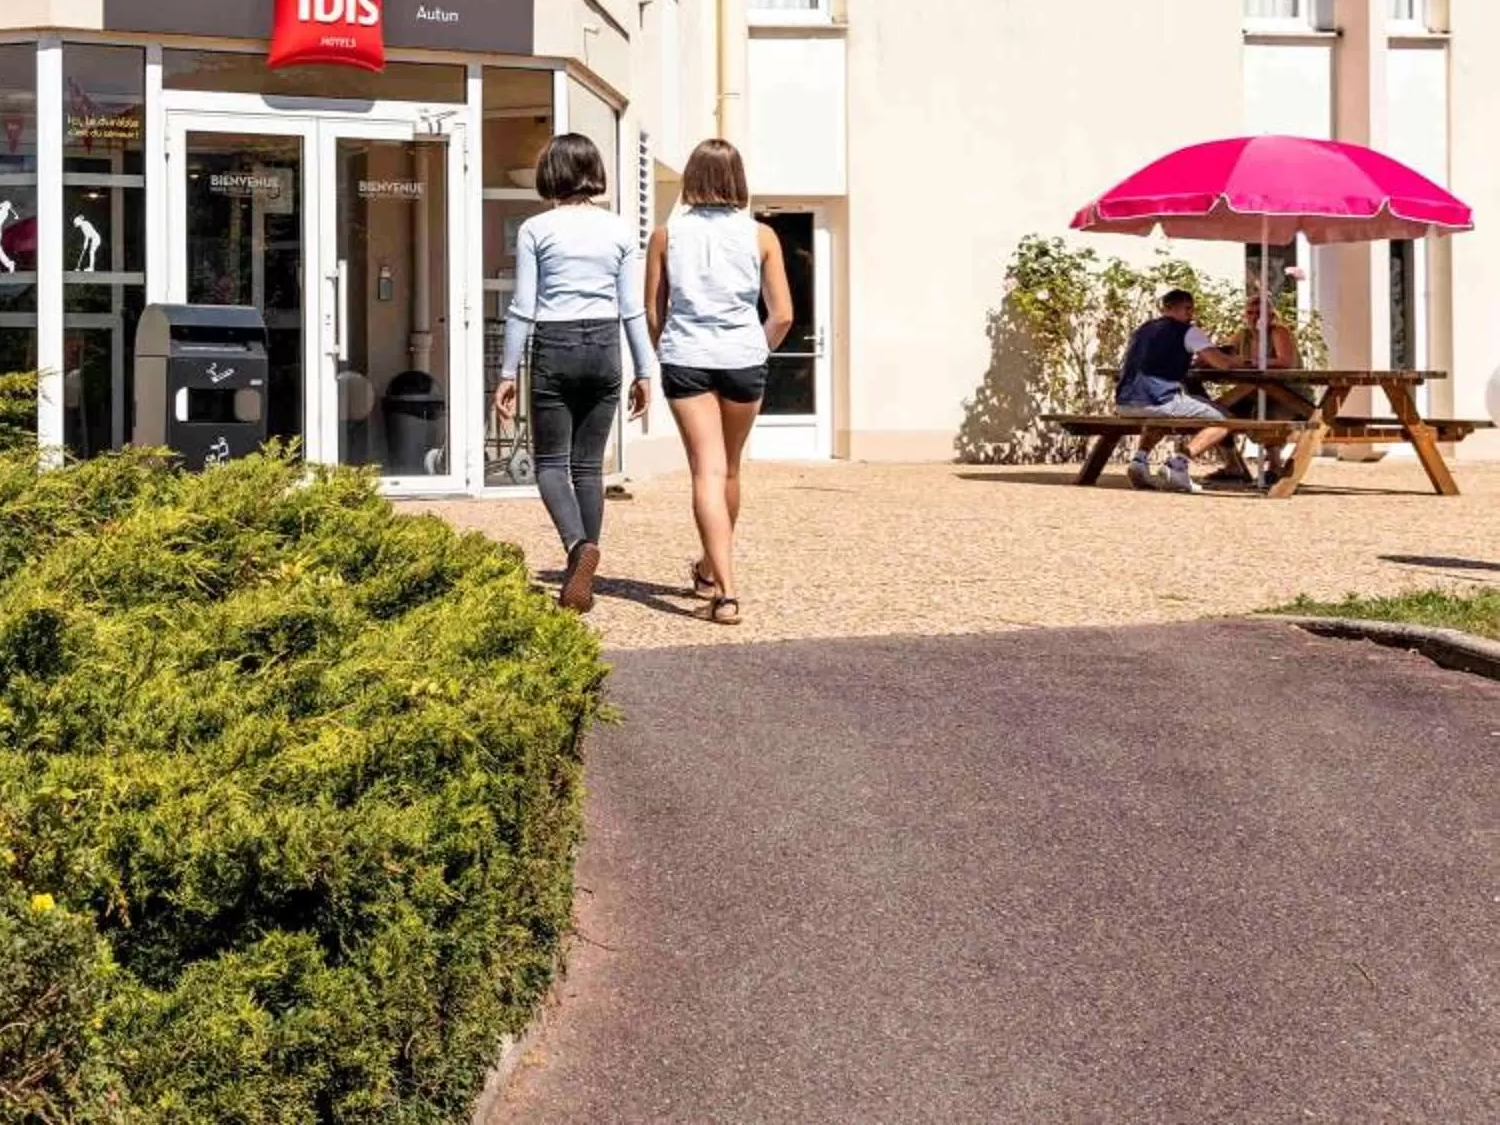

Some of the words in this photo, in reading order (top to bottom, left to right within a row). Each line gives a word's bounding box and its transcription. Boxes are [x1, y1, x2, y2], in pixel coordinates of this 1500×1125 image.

[415, 4, 459, 22] Autun
[320, 36, 357, 48] HOTELS
[210, 174, 279, 188] BIENVENUE
[358, 180, 424, 194] BIENVENUE
